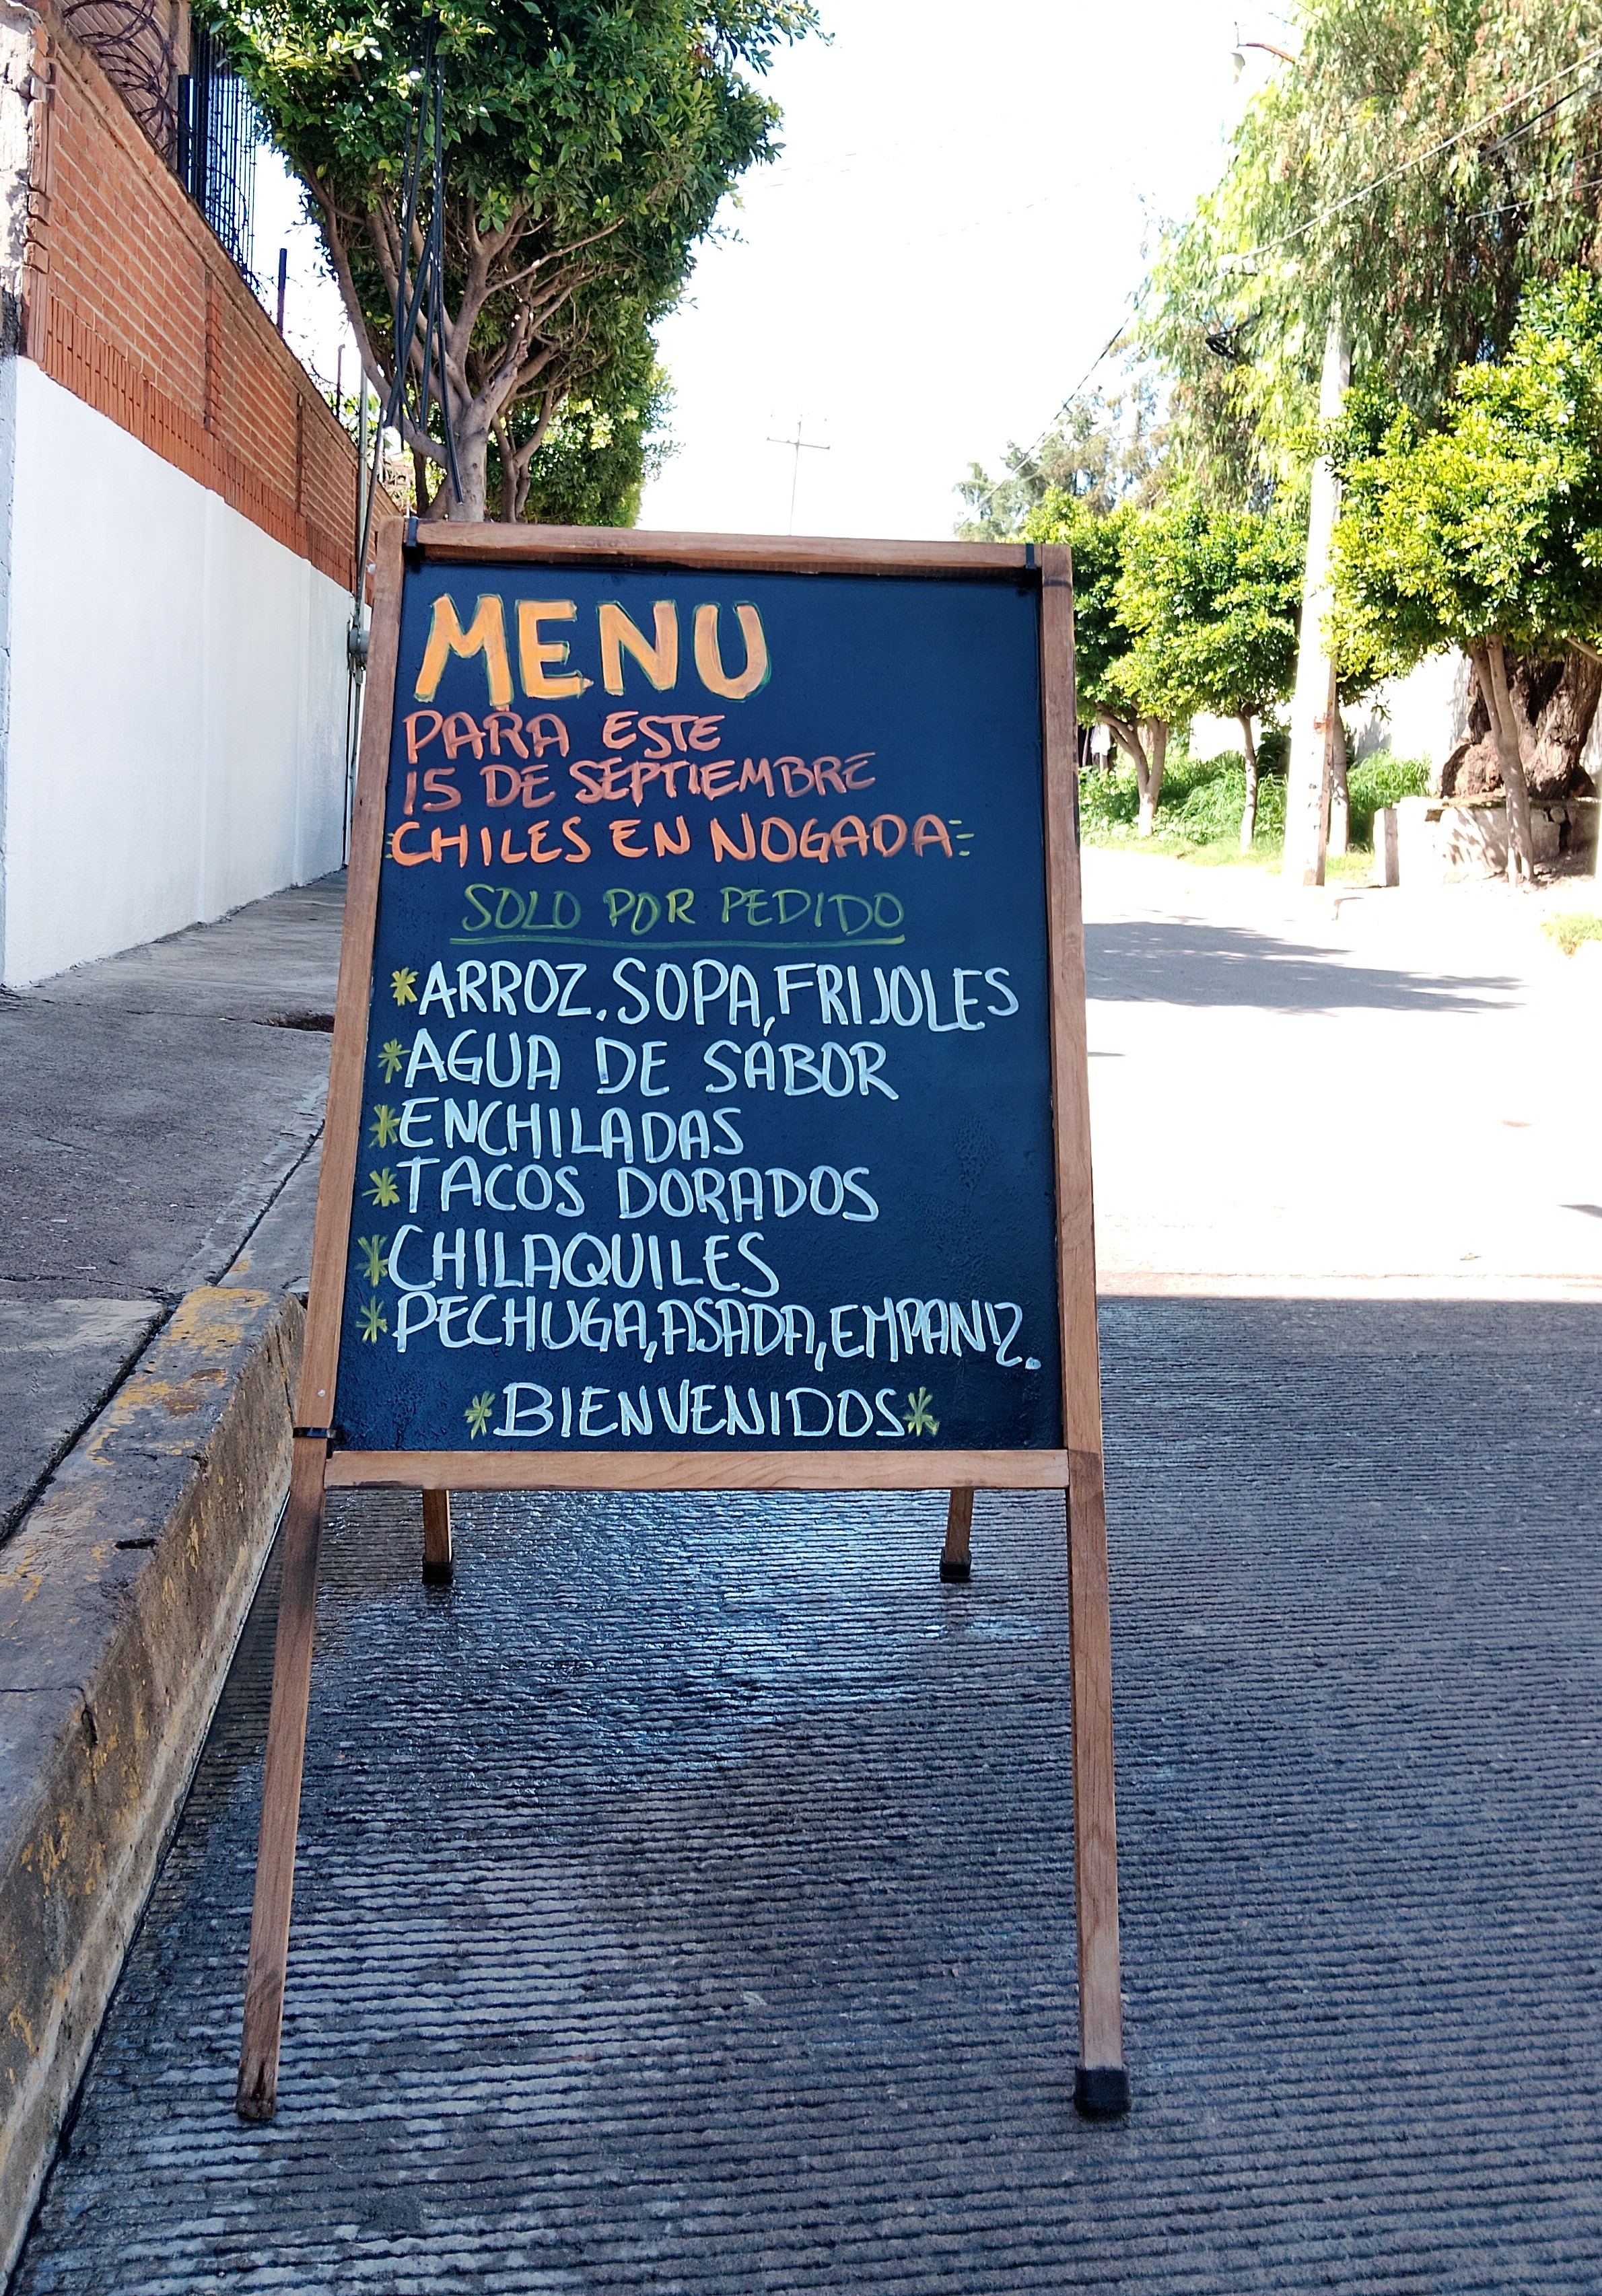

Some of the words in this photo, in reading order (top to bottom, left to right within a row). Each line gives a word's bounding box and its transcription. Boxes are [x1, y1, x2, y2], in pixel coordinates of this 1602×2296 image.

[413, 591, 771, 708] MENU
[405, 710, 570, 764] PARA
[602, 711, 725, 760] ESTE
[404, 770, 461, 814] 15
[481, 764, 556, 808] DE
[568, 752, 876, 807] SEPTIEMBRE
[392, 816, 591, 867] CHILES
[609, 815, 691, 859] EN
[709, 813, 954, 863] NOGADA
[462, 884, 581, 932] SOLO
[604, 888, 696, 935] POR
[721, 886, 905, 935] PEDIDO
[773, 962, 1018, 1032] FRIJOLES
[404, 1028, 560, 1090] AGUA
[596, 1036, 669, 1096] DE
[705, 1040, 899, 1100] SABOR
[398, 1097, 744, 1163] ENCHILADAS
[396, 1155, 584, 1217] TACOS
[617, 1164, 880, 1224] DORADOS
[388, 1224, 780, 1297] CHILAQUILES
[493, 1379, 911, 1438] BIENVENIDOS
